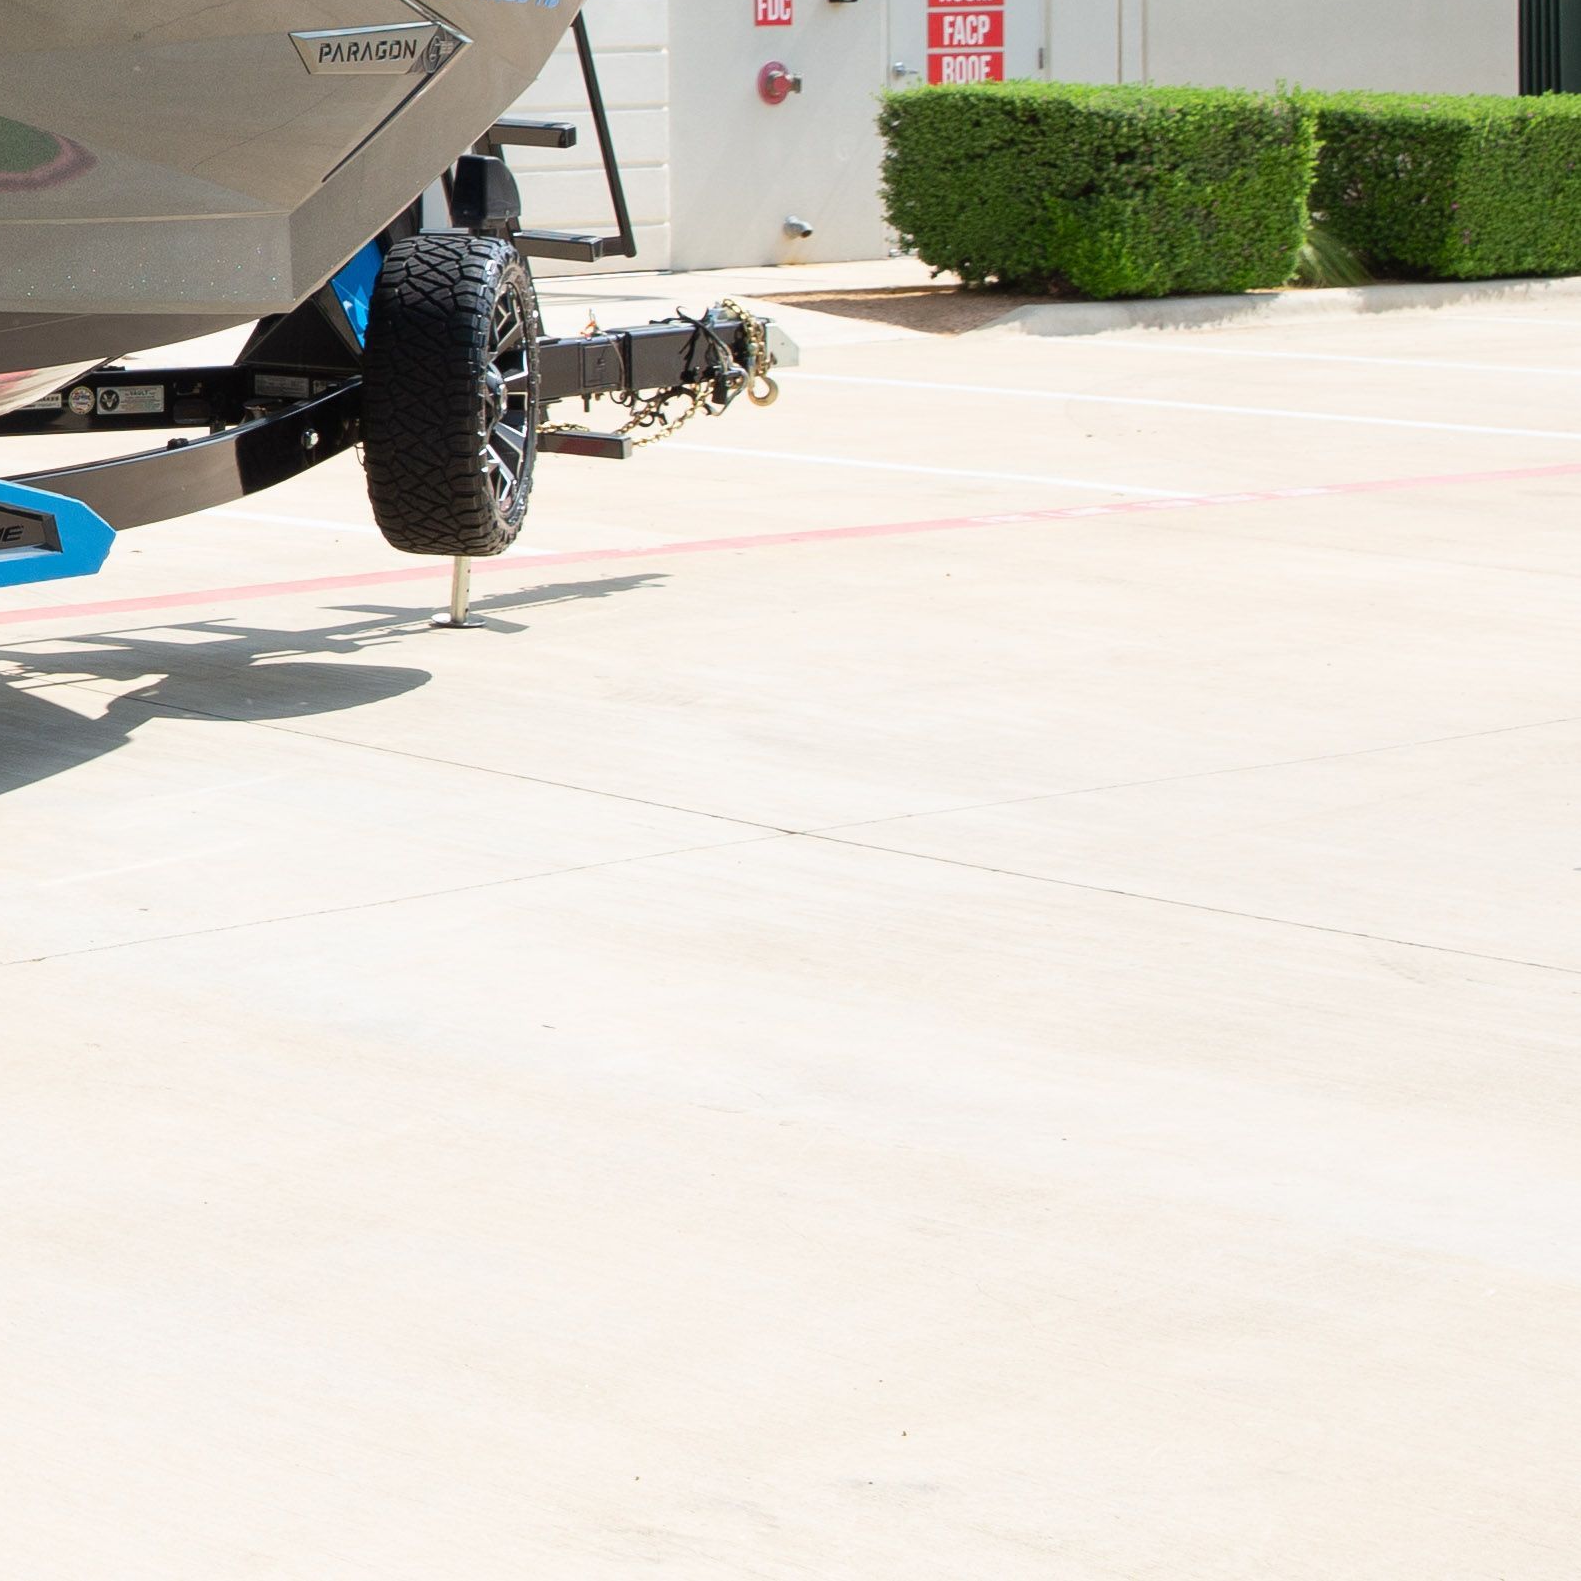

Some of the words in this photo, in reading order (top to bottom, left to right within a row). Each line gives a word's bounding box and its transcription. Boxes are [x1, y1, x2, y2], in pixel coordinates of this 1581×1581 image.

[942, 15, 991, 46] FACP
[317, 38, 418, 64] PARAGON
[942, 55, 992, 84] ROOF
